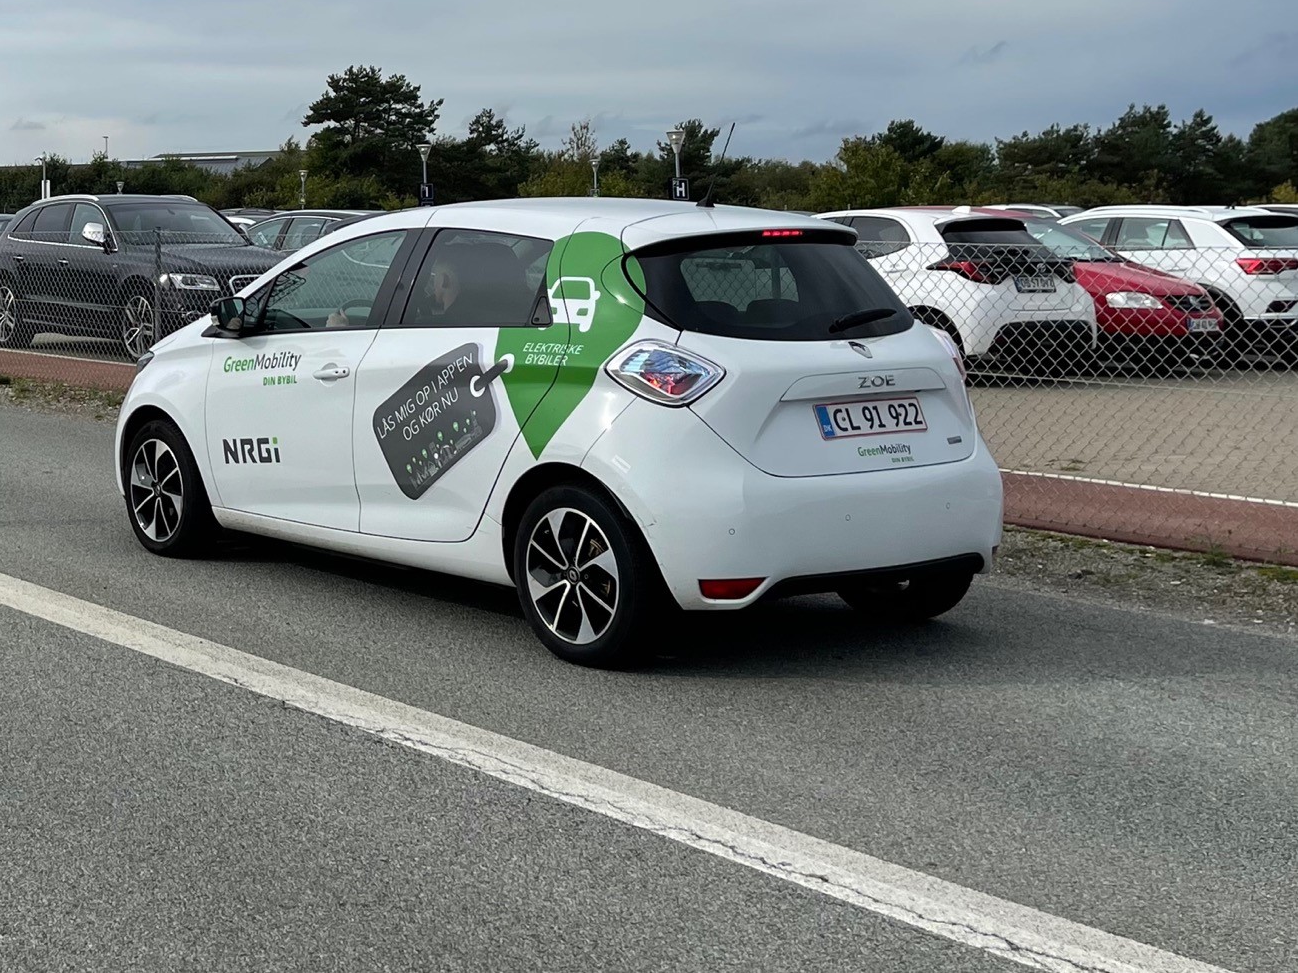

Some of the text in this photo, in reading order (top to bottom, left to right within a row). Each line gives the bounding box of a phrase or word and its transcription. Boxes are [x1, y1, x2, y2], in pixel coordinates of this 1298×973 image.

[522, 342, 584, 354] ELEKTRISKE
[223, 351, 302, 373] GreenMobility
[525, 353, 568, 366] BYBILER
[262, 375, 297, 386] DIN BYBIL
[858, 375, 896, 389] ZOE
[377, 352, 473, 439] LÅS MIG OP I APP'EN
[402, 386, 459, 440] OG KØR NU
[833, 407, 861, 432] CL
[861, 405, 887, 429] 91
[888, 402, 924, 427] 922
[222, 437, 281, 464] NRGi
[857, 443, 911, 457] GreenMobility
